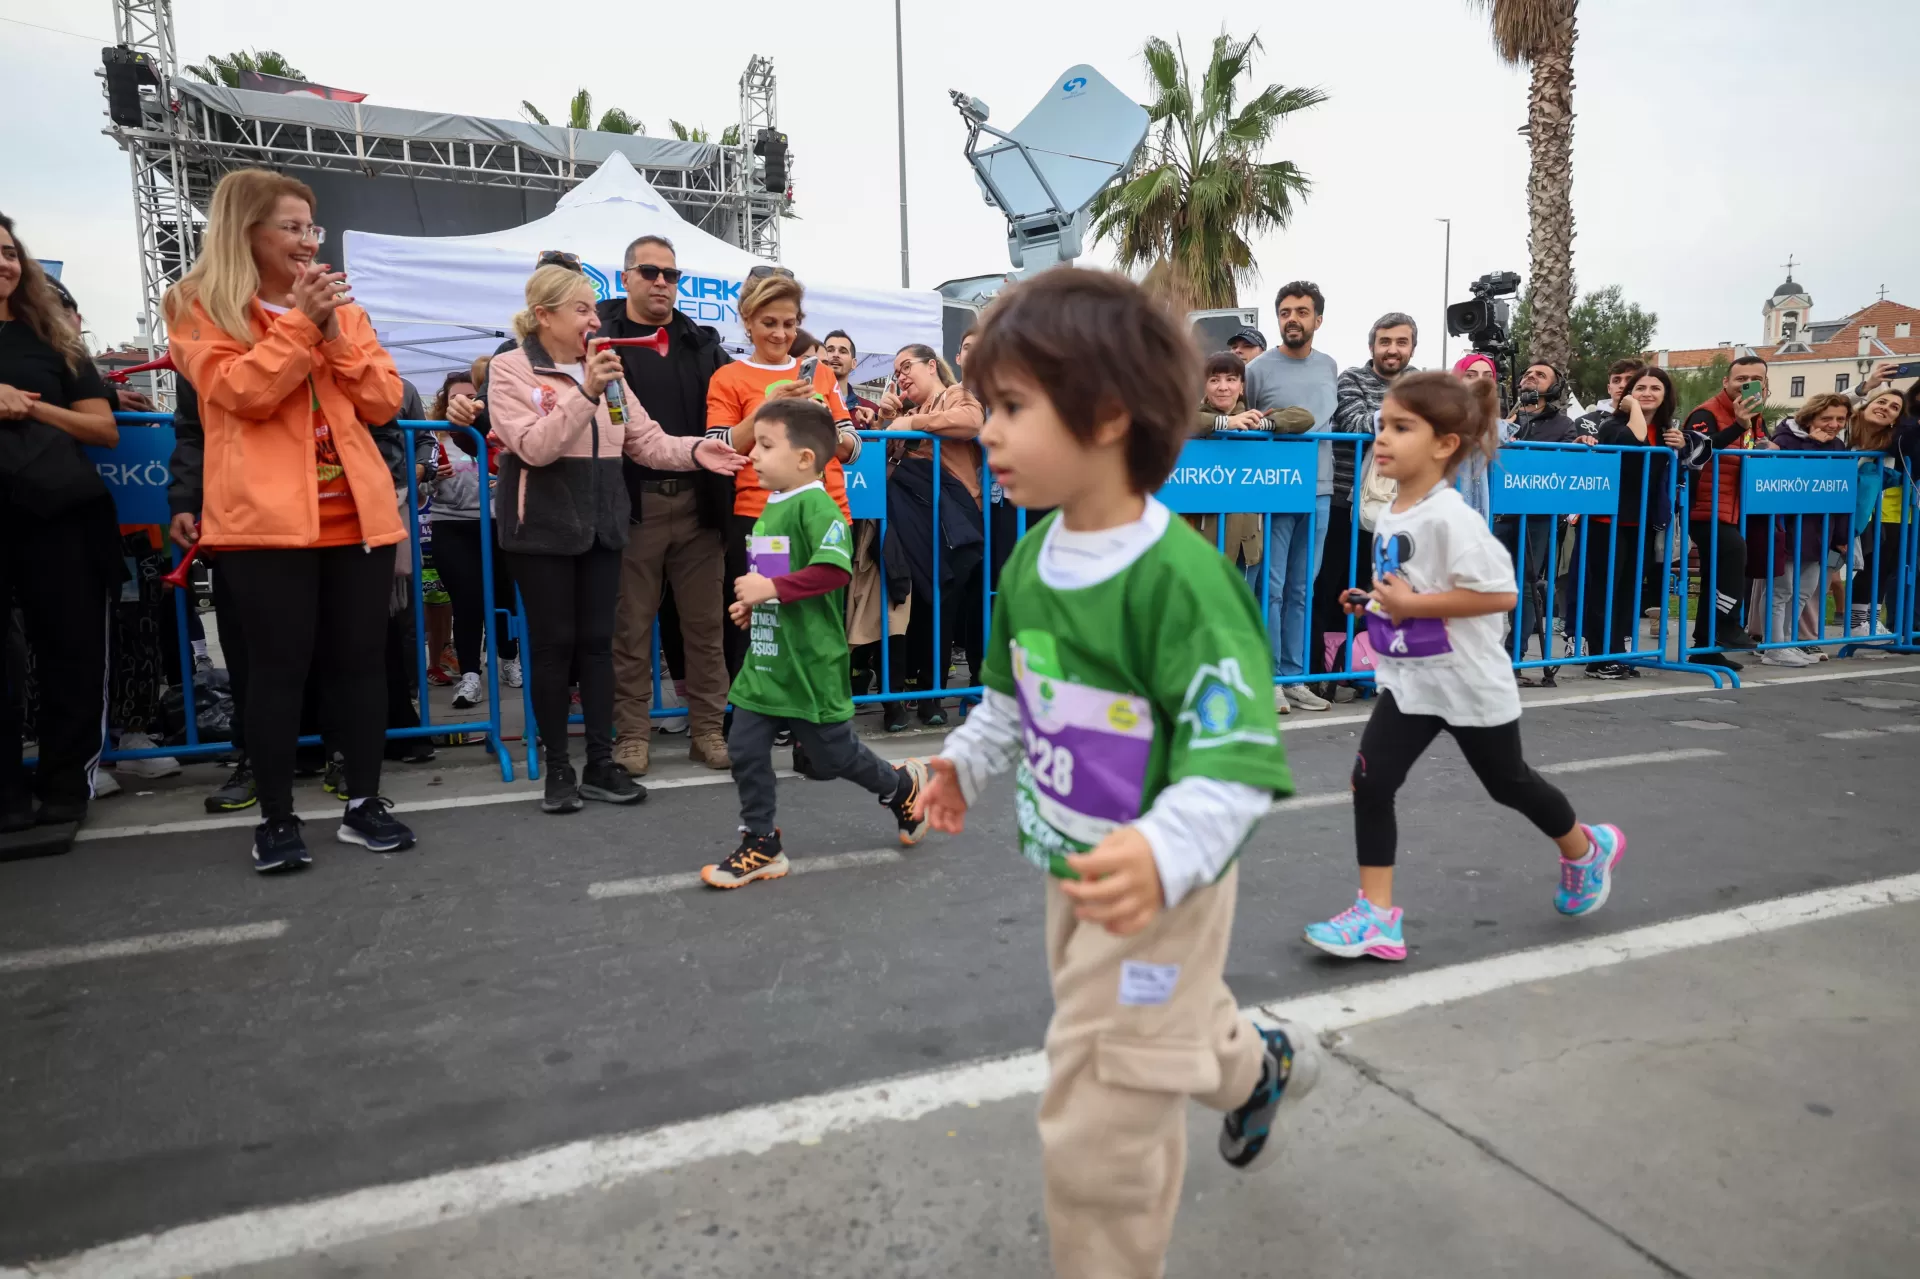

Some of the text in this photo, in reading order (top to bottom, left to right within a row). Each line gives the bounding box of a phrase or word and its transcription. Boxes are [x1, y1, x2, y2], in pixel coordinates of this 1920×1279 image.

[96, 460, 169, 486] RKÖ
[843, 471, 868, 489] TA
[1165, 465, 1303, 485] KIRKÖY ZABITA
[1569, 475, 1611, 491] ZABITA
[1755, 477, 1849, 492] BAKIRKÖY ZABITA
